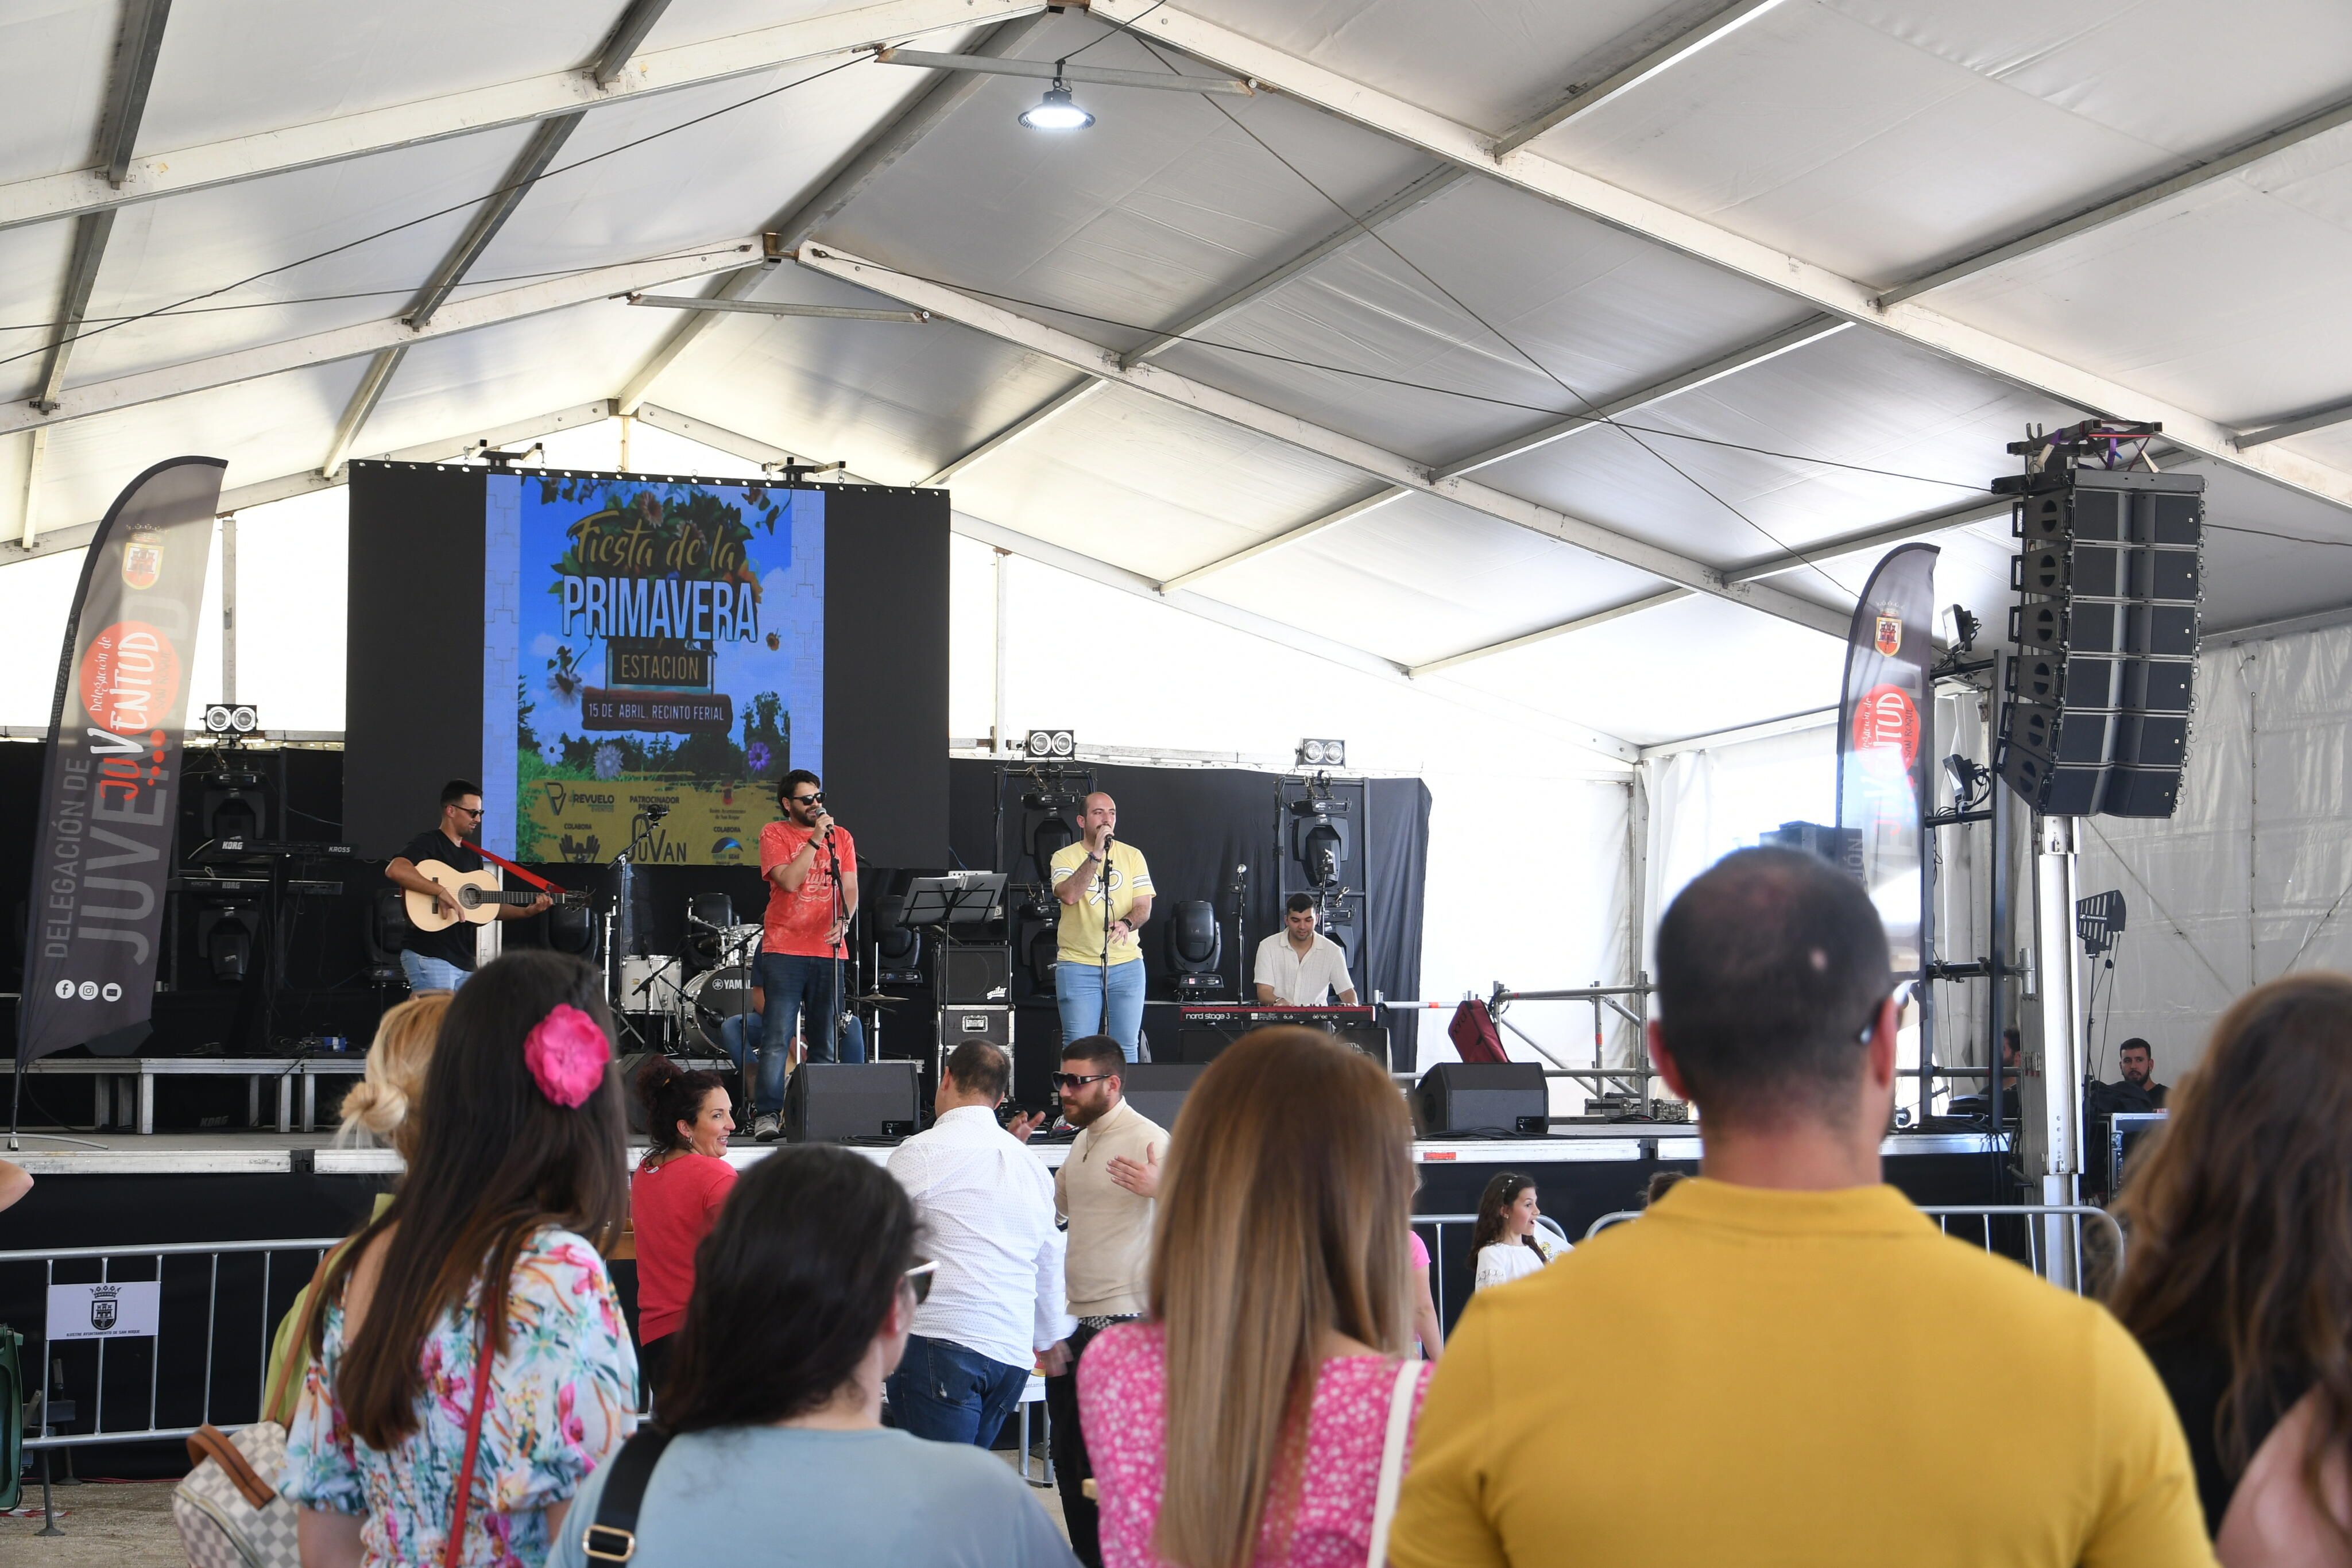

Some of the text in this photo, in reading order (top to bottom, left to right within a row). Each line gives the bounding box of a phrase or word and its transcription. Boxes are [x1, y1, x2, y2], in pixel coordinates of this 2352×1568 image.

[566, 509, 739, 571] Fiesta de la
[562, 574, 759, 642] PRIMAVERA
[90, 637, 112, 711] Delegación de
[621, 652, 699, 681] ESTACIÓN
[1862, 697, 1873, 708] de
[87, 632, 159, 802] JUVENTUD
[589, 703, 725, 722] 15 DE ABRIL. RECINTO FERIAL
[1904, 707, 1913, 758] SAN ROQUE
[574, 794, 614, 804] REVUELO
[629, 795, 680, 804] PATROCINADOR
[222, 841, 243, 850] KORG
[44, 758, 91, 959] DELEGACIÓN DE
[222, 881, 240, 889] KORG
[1205, 1012, 1225, 1020] stage
[199, 1115, 229, 1127] KORG
